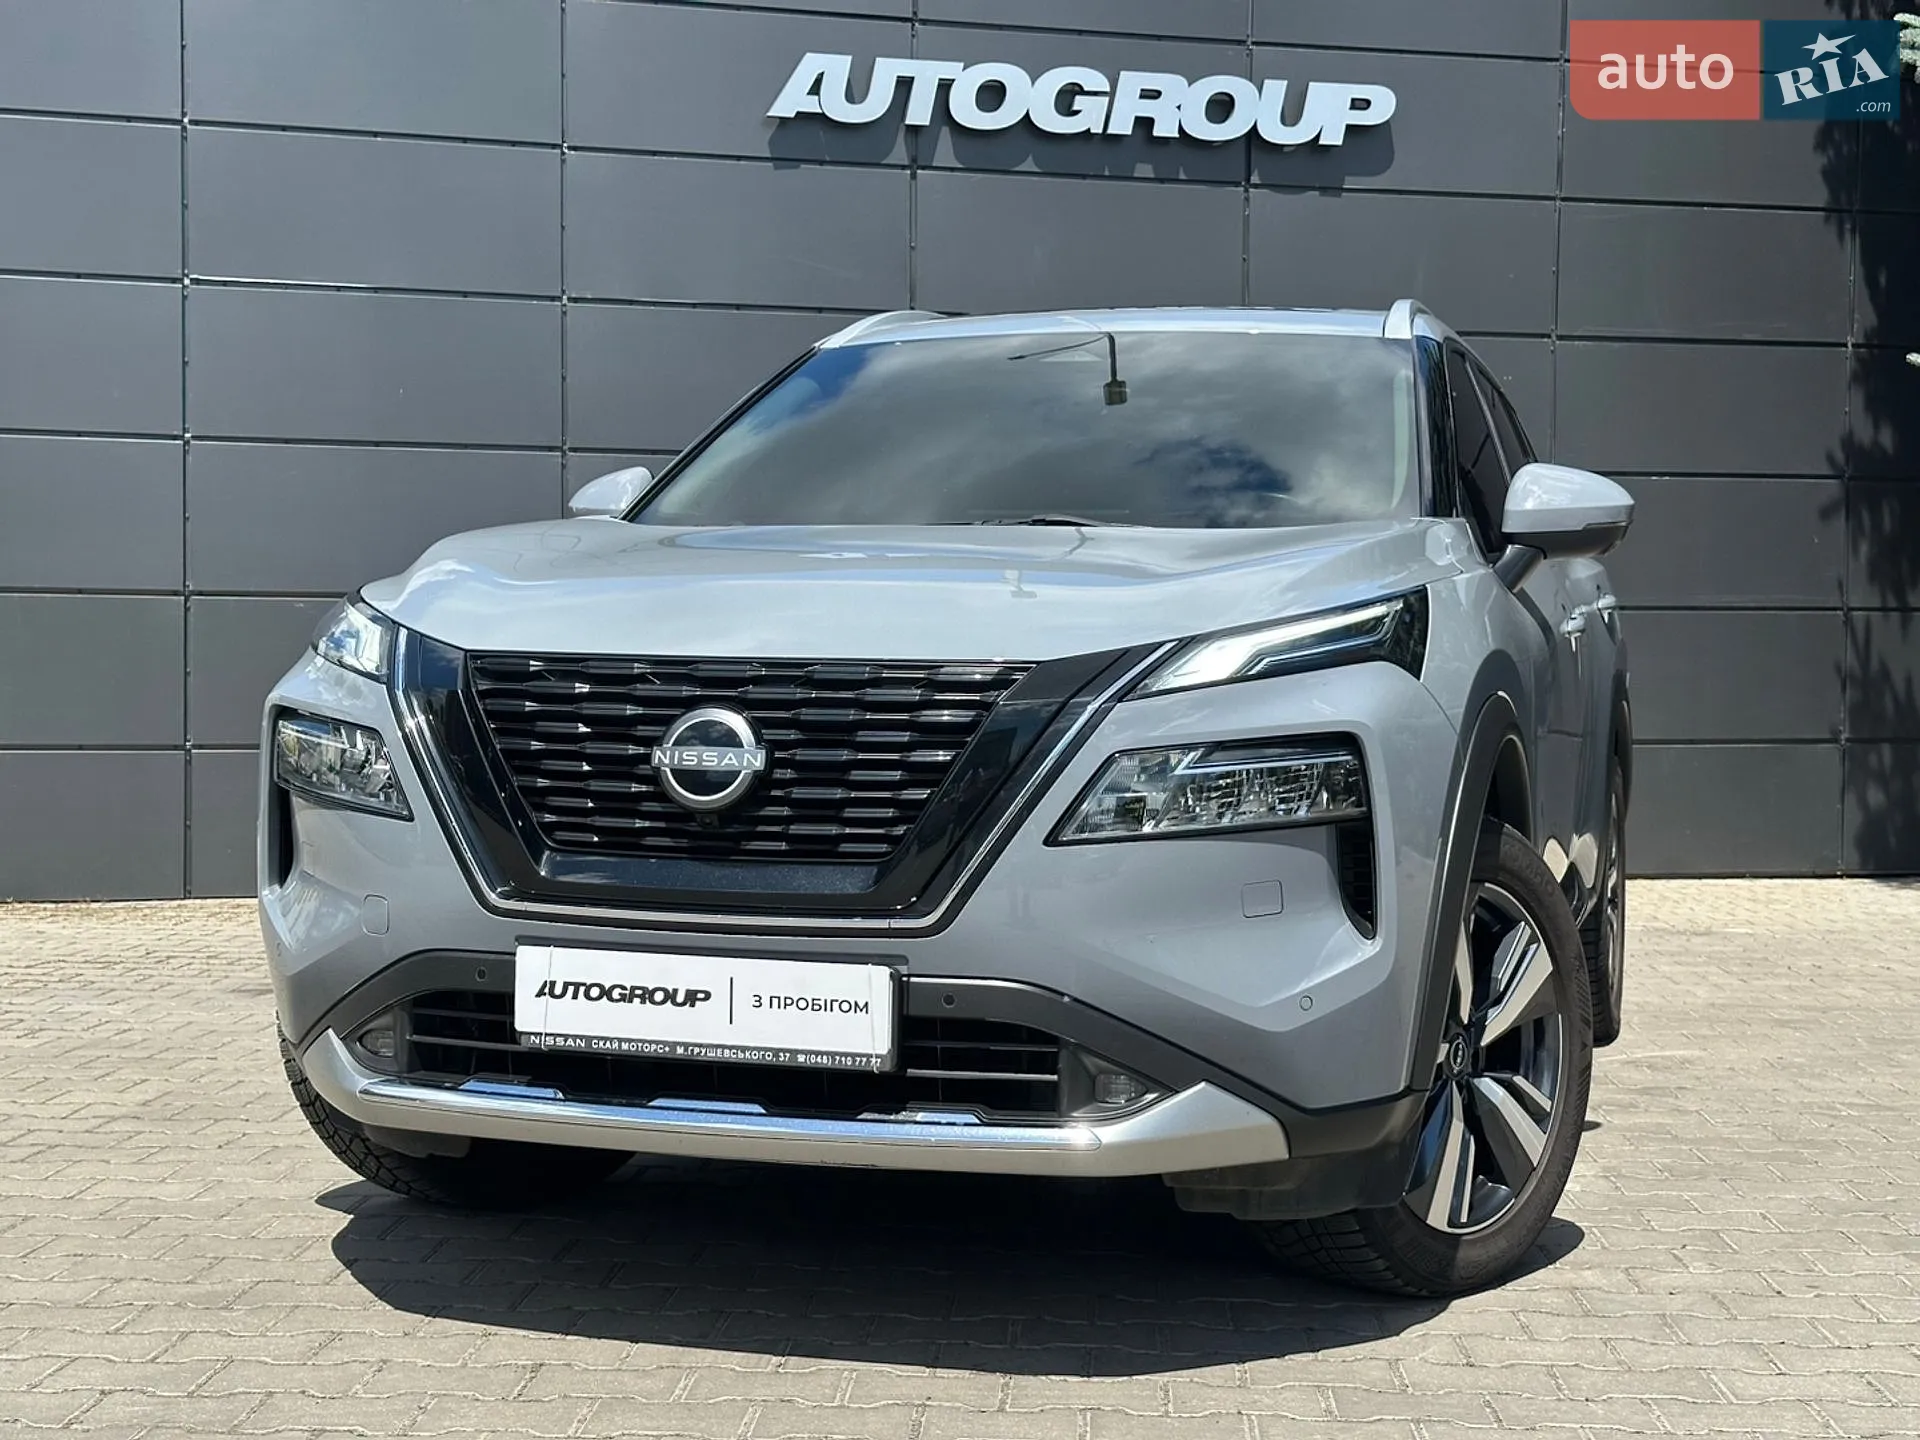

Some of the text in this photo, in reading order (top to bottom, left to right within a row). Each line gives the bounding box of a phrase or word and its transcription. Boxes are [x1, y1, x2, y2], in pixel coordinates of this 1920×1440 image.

[766, 52, 1396, 146] AUTOGROUP
[654, 750, 761, 767] NISSAN
[535, 980, 712, 1008] AUTOGROUP
[752, 994, 869, 1015] З ПРОБІГОМ
[592, 1038, 619, 1050] СКАЙ
[779, 1052, 791, 1062] 37
[834, 1055, 852, 1066] 710
[855, 1056, 867, 1067] 77
